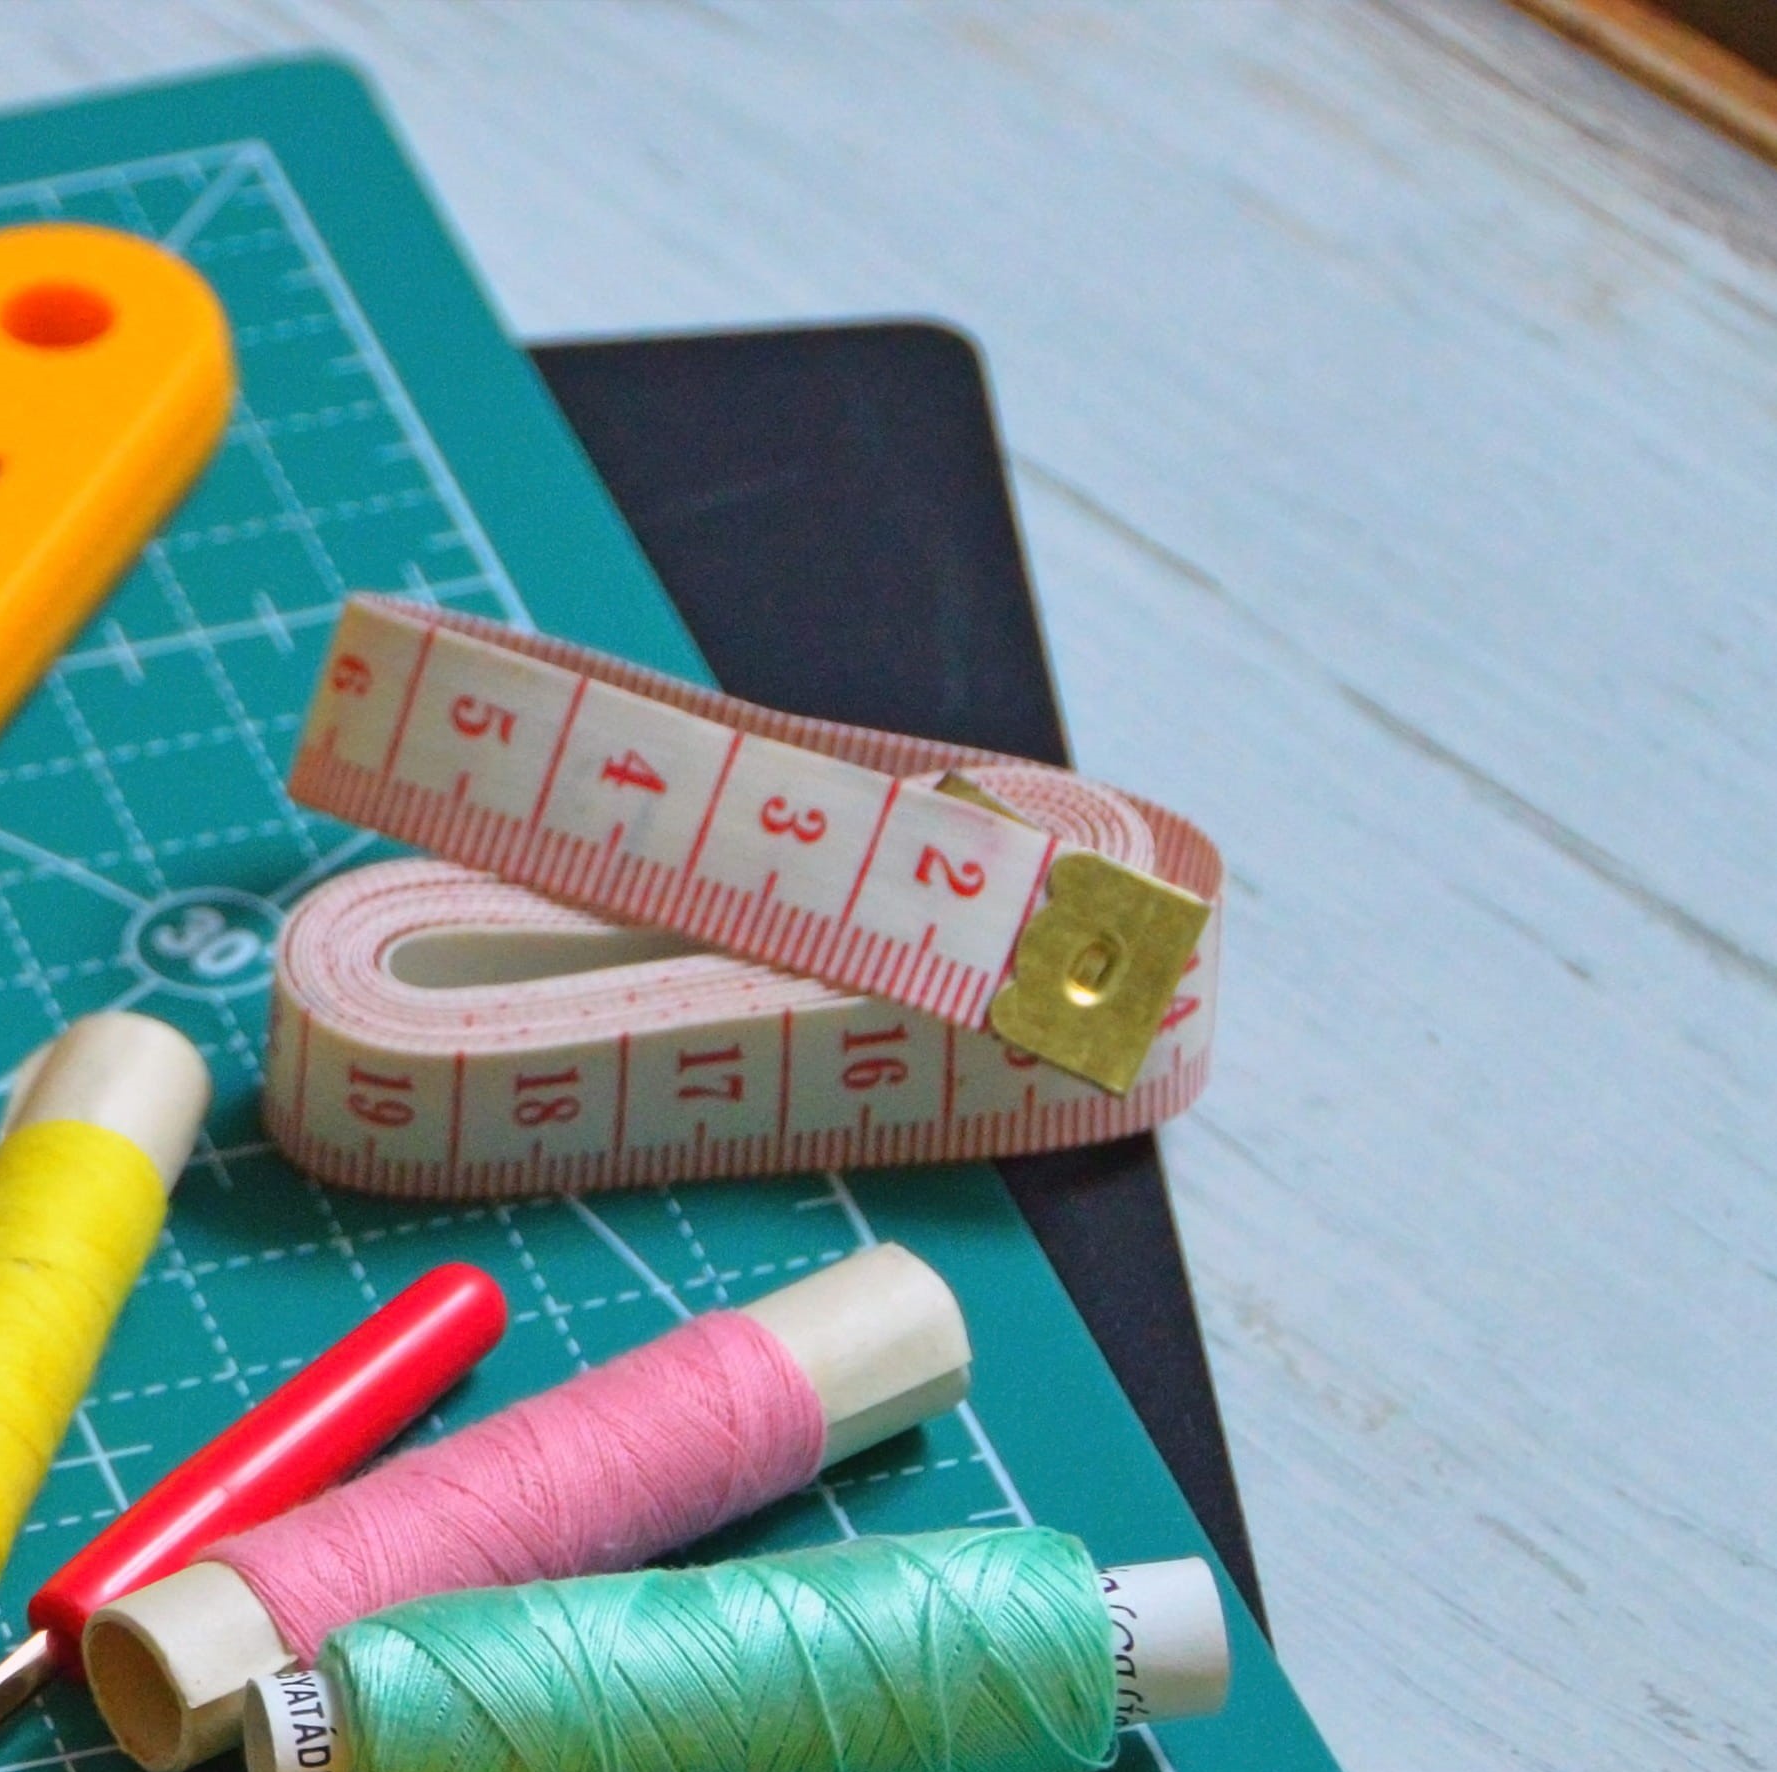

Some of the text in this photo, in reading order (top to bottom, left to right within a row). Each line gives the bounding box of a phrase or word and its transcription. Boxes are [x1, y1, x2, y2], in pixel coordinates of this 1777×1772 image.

[333, 655, 987, 898] 6 5 4 3 2
[344, 1024, 910, 1128] 19 18 17 16
